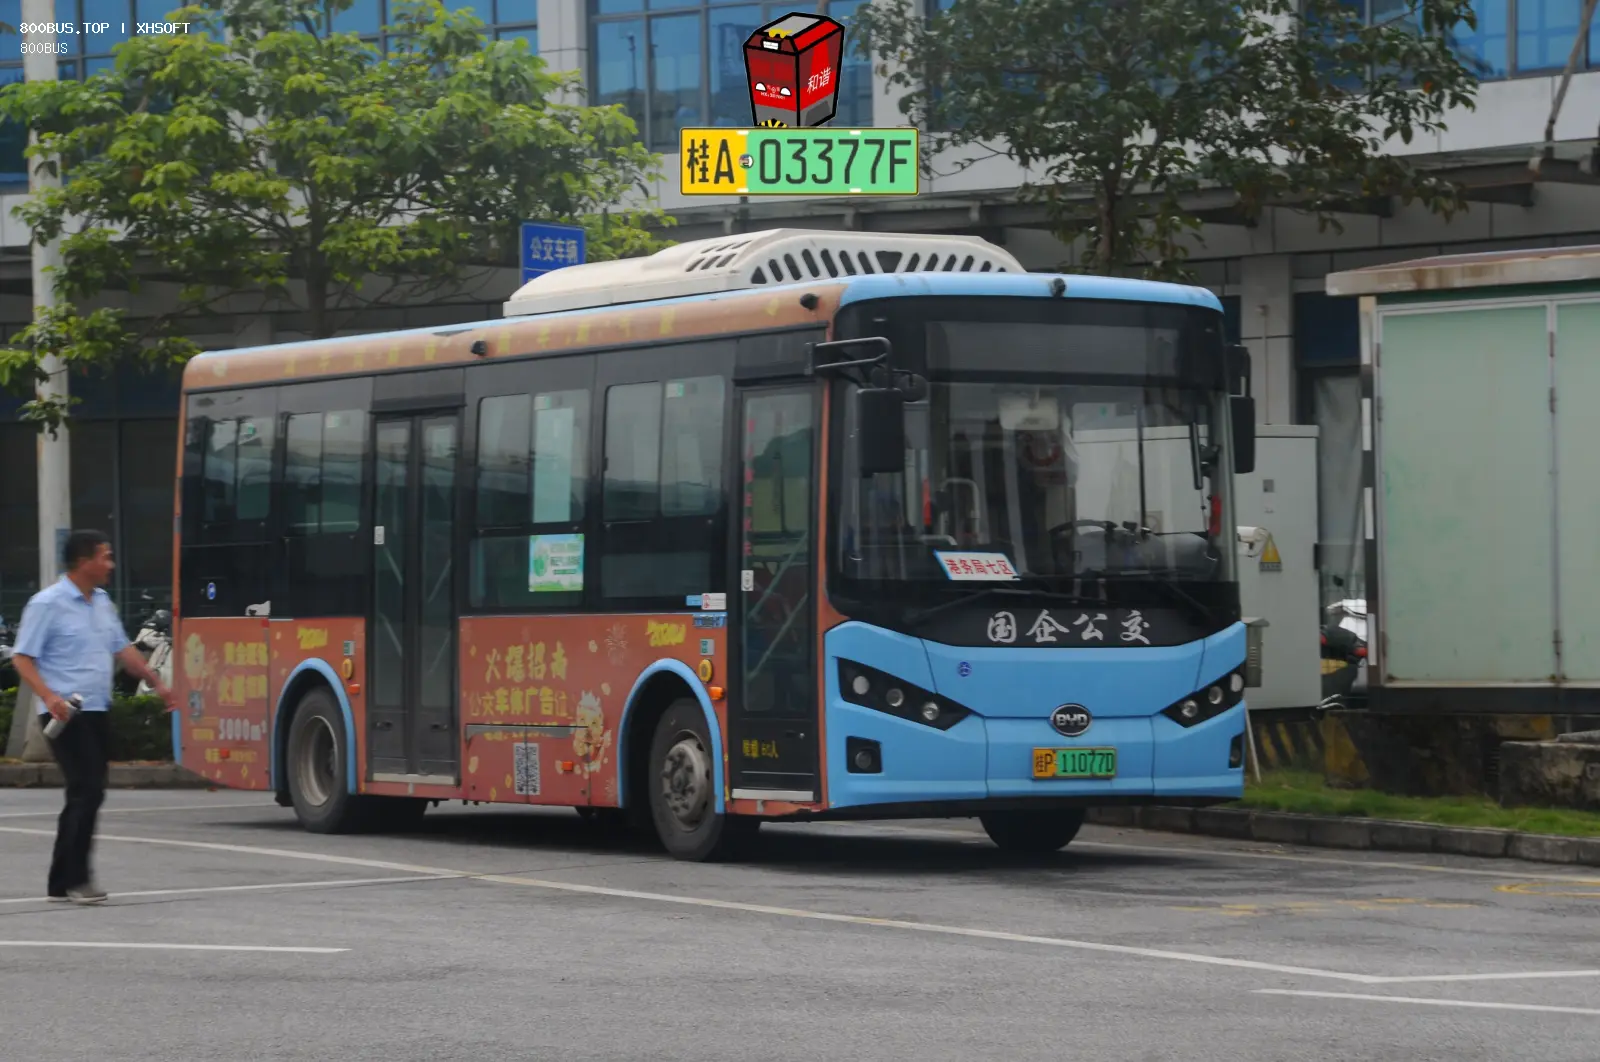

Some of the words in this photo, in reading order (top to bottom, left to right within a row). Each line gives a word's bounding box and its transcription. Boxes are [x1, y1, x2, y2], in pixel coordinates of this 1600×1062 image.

[530, 236, 578, 264] 公交车辆
[945, 558, 1014, 576] 港务局七区
[987, 609, 1151, 645] 国企公交
[1055, 713, 1088, 727] BYD
